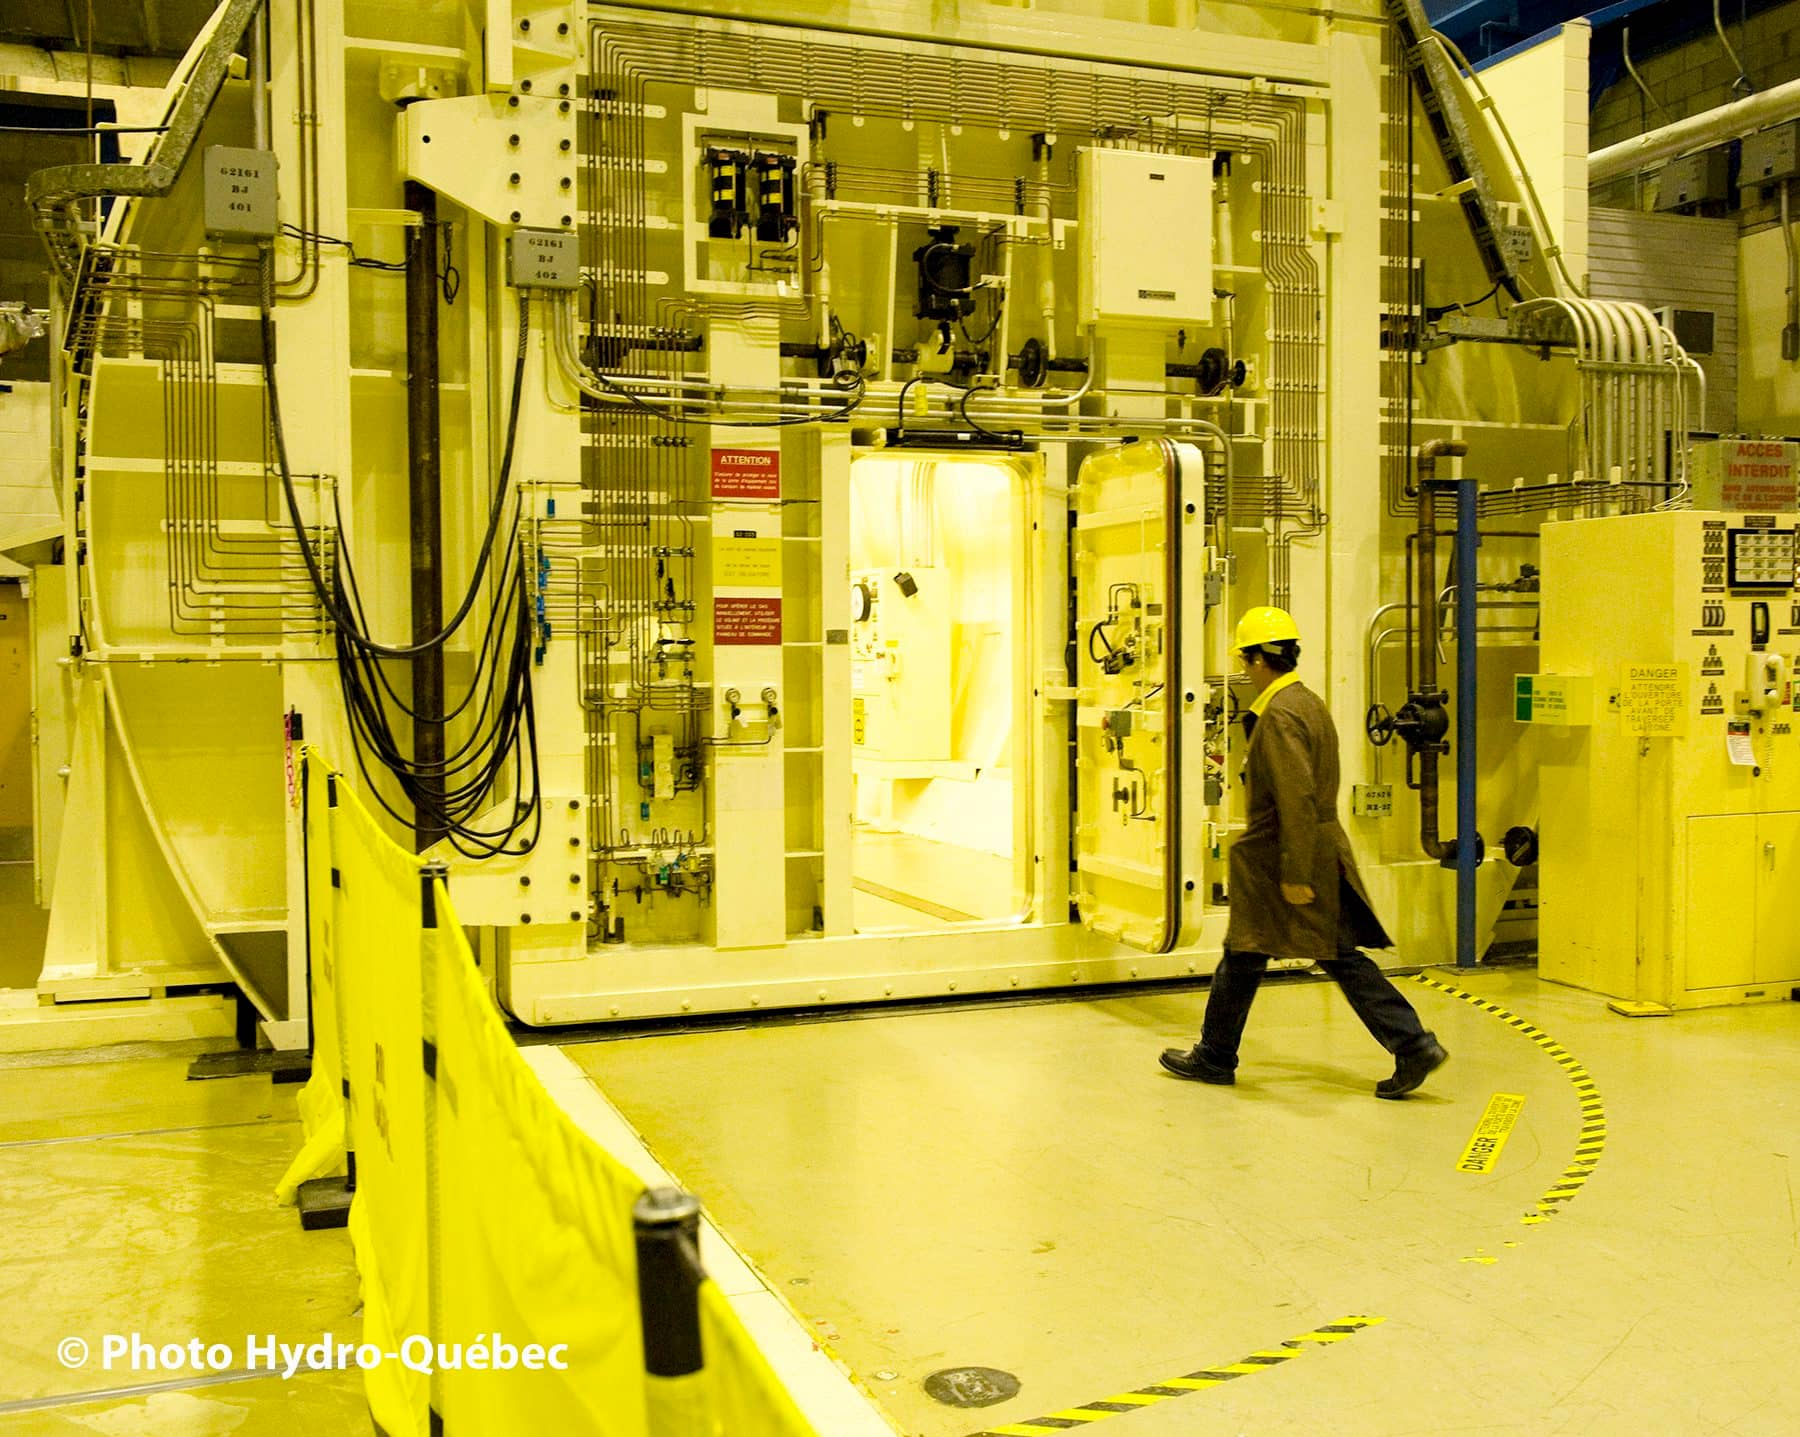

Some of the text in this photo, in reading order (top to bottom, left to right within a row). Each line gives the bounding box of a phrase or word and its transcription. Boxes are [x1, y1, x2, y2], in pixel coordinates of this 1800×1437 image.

[231, 184, 249, 194] BJ
[228, 202, 251, 212] 401
[538, 254, 554, 263] BJ
[535, 270, 558, 279] 402
[720, 455, 771, 466] ATTENTION
[1728, 463, 1791, 478] INTERDIT
[1630, 668, 1678, 678] DANGER
[1631, 683, 1678, 692] ATTENDRE
[1638, 699, 1650, 707] LA
[1655, 699, 1684, 708] PORTE
[1625, 714, 1675, 722] TRAVERSER
[1462, 1137, 1498, 1171] DANGER
